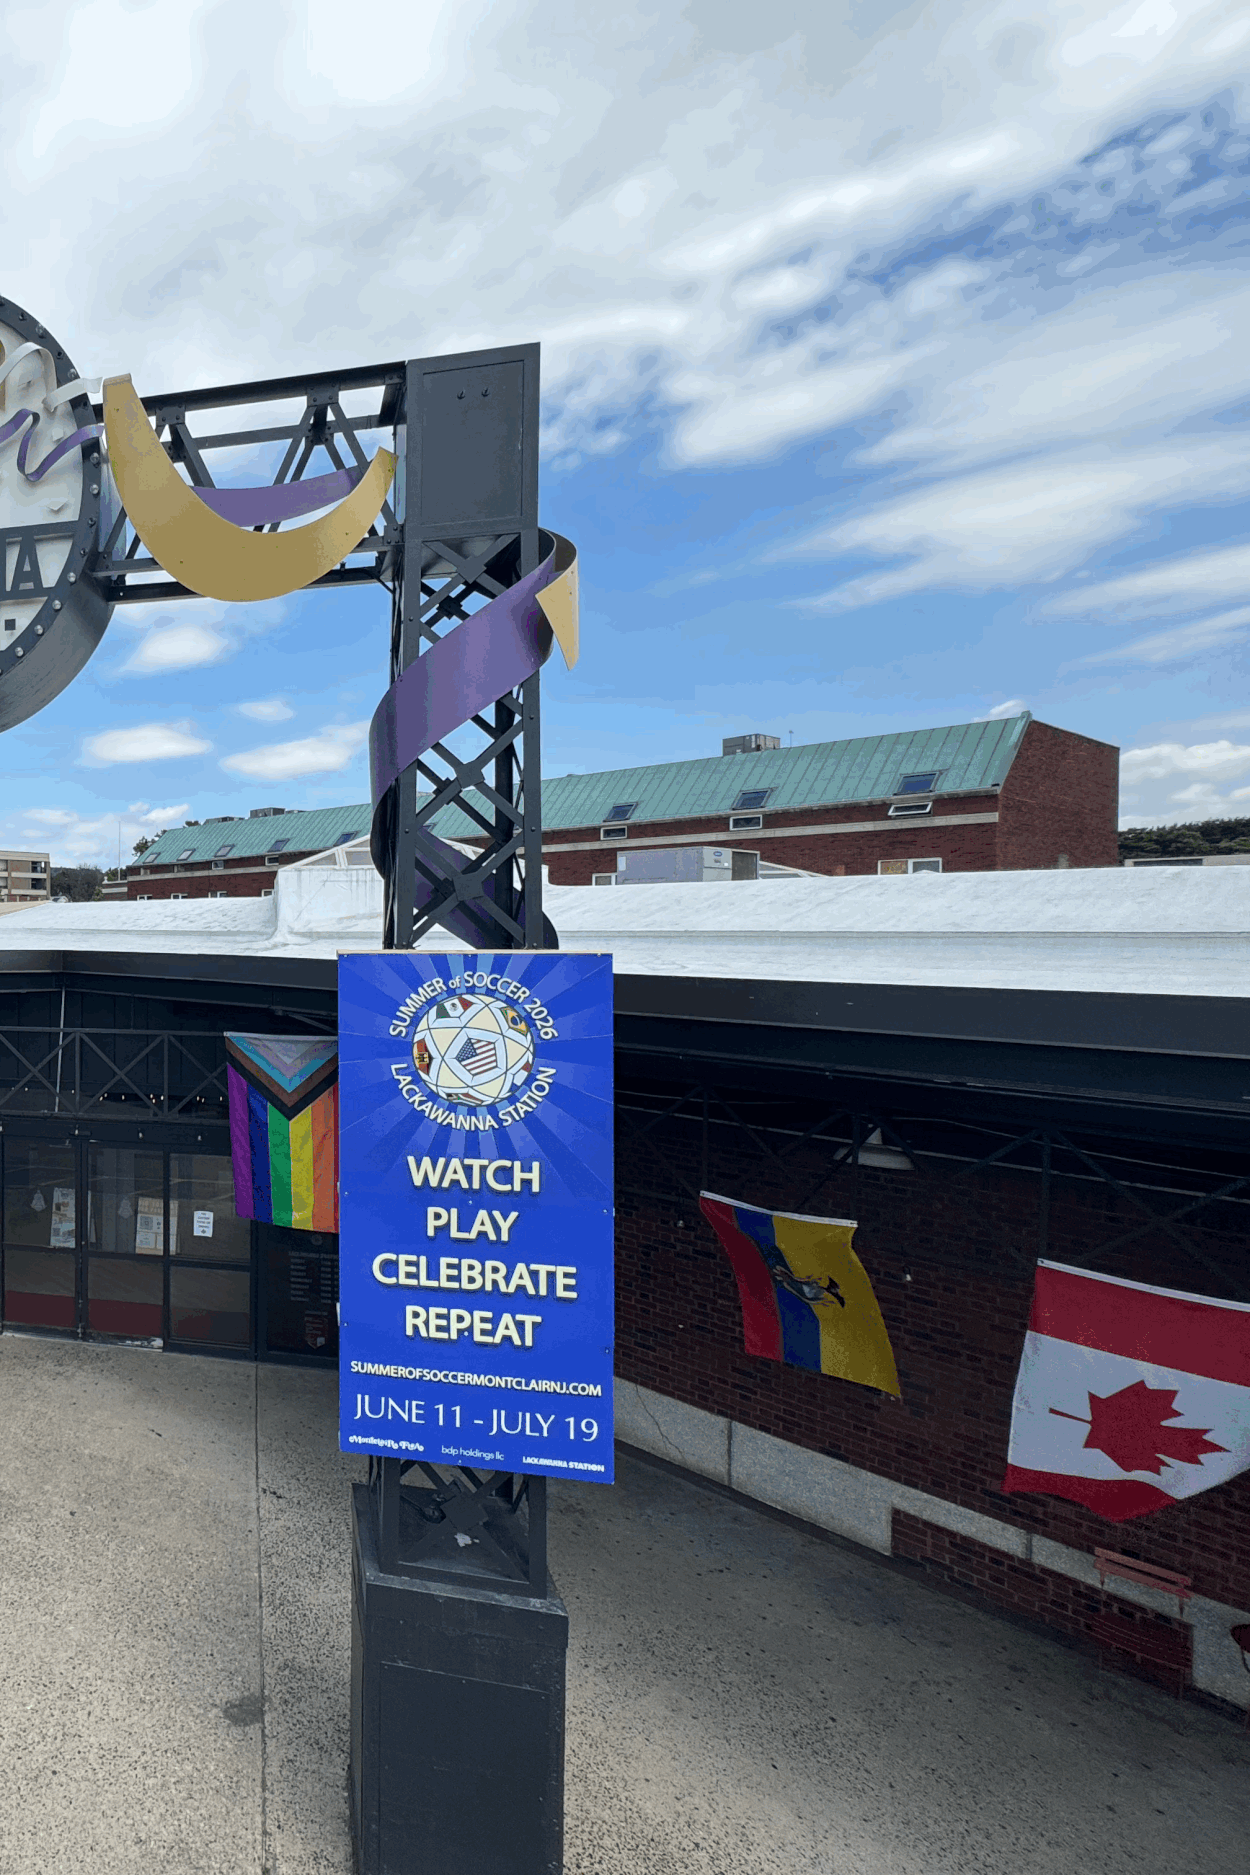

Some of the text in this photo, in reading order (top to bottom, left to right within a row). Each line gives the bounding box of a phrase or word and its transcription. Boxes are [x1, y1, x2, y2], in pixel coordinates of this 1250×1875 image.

[389, 971, 558, 1040] SUMMER of SOCCER 2026
[390, 1062, 557, 1131] LACKAWANNA STATION
[406, 1155, 540, 1193] WATCH
[426, 1206, 519, 1242] PLAY
[372, 1252, 578, 1299] CELEBRATE
[405, 1304, 542, 1347] REPEAT
[350, 1360, 602, 1397] SUMMEROFSOCCERMONTCLAIRNJ.COM
[353, 1393, 425, 1424] JUNE
[434, 1403, 461, 1428] 11
[488, 1408, 555, 1437] JULY
[564, 1416, 599, 1442] 19
[441, 1444, 505, 1461] bdp holdings llc
[568, 1461, 605, 1473] STATION
